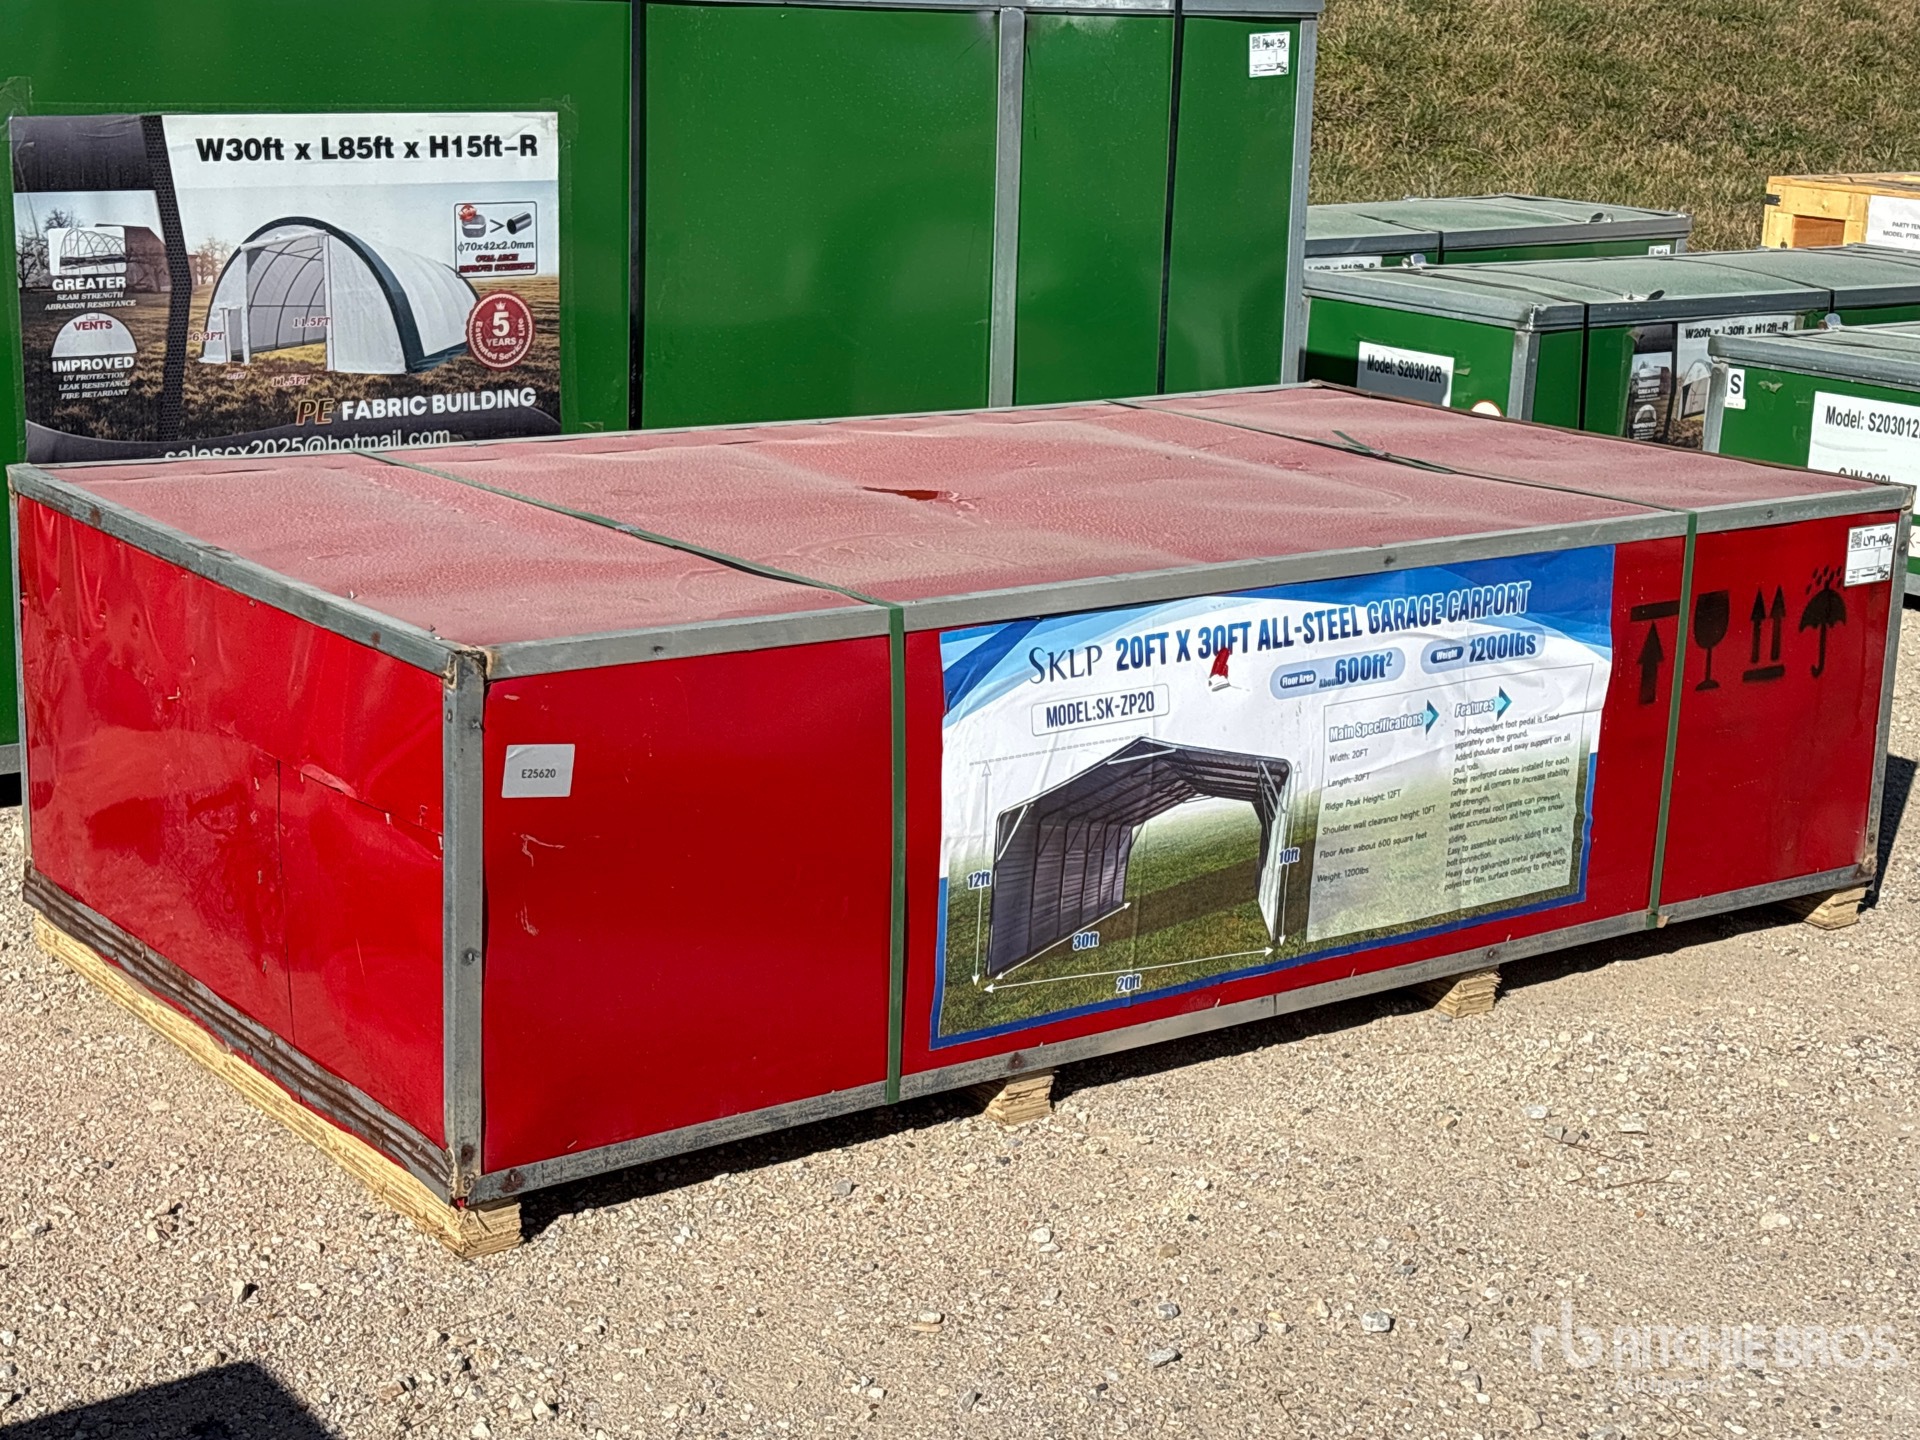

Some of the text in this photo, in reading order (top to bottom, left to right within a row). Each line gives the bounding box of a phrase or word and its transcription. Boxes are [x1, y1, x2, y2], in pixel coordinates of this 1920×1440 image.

[196, 134, 538, 162] W30ft x L85ft x H15ft-R
[1883, 230, 1904, 238] MODEL:
[52, 276, 126, 290] GREATER
[81, 291, 124, 300] STRENGTH
[44, 300, 136, 310] ABRASION RESISTANCE
[74, 320, 113, 330] VENTS
[292, 317, 330, 327] 11.5FT
[492, 312, 510, 336] 5
[1686, 326, 1711, 339] W20ft
[1755, 322, 1788, 334] H12ft-R
[192, 332, 224, 342] 6.3FT
[476, 321, 498, 360] Estimated
[498, 338, 524, 360] Service
[486, 338, 516, 346] YEARS
[52, 356, 134, 372] IMPROVED
[1366, 354, 1443, 384] Model: S203012R
[76, 372, 125, 381] PROTECTION
[82, 380, 130, 389] RESISTANCE
[1730, 374, 1742, 394] S
[82, 389, 129, 398] RETARDANT
[295, 387, 536, 426] PE FABRIC BUILDING
[1825, 405, 1920, 438] Model: S203012
[1028, 580, 1532, 684] SKLP 20FT X 30FT ALL-STEEL GARAGE CARPORT
[1436, 632, 1536, 662] Weight 1200lbs
[1282, 673, 1314, 686] Floor Area
[1046, 691, 1155, 728] MODEL:SK-ZP20
[1454, 700, 1495, 718] Features
[1329, 713, 1424, 742] Main Specifications
[1467, 724, 1503, 735] independent
[1519, 718, 1535, 728] pedal
[1454, 738, 1484, 750] separately
[1507, 730, 1528, 742] ground.
[1330, 748, 1368, 763] Width: 20FT
[1455, 751, 1472, 762] Added
[1474, 748, 1500, 757] shoulder
[1502, 745, 1512, 753] and
[1530, 738, 1552, 748] support
[522, 768, 556, 779] E25620
[1452, 776, 1467, 785] Steel
[1470, 770, 1497, 782] reinforced
[1498, 766, 1519, 776] cables
[1521, 762, 1544, 772] installed
[1556, 756, 1570, 765] each
[1454, 765, 1465, 776] pull
[1328, 772, 1370, 788] Length: 30FT
[1451, 789, 1468, 797] rafter
[1491, 778, 1511, 789] corners
[1522, 773, 1546, 783] increase
[1547, 769, 1570, 779] stability
[1324, 802, 1343, 811] Ridge
[1346, 800, 1360, 808] Peak
[1387, 788, 1401, 799] 12FT
[1449, 810, 1471, 820] Vertical
[1473, 806, 1491, 815] metal
[1506, 800, 1522, 810] panels
[1537, 793, 1560, 802] prevent
[1450, 796, 1490, 808] and strength.
[1322, 824, 1351, 836] Shoulder
[1354, 820, 1366, 829] wall
[1368, 816, 1398, 827] clearance
[1422, 805, 1436, 815] 10FT
[1449, 822, 1465, 832] water
[1466, 815, 1507, 828] accumulation
[1509, 812, 1518, 820] and
[1520, 809, 1532, 817] help
[1548, 803, 1564, 811] snow
[1338, 847, 1356, 856] Area:
[1358, 843, 1376, 852] about
[1378, 838, 1391, 848] 600
[1393, 834, 1413, 844] square
[1416, 831, 1427, 839] feet
[1448, 848, 1460, 856] Easy
[1470, 838, 1497, 850] assemble
[1551, 824, 1562, 833] and
[1449, 834, 1467, 844] sliding.
[1279, 849, 1300, 865] 10ft
[1445, 847, 1566, 878] Heavy duty galvanized metal grating with
[1446, 852, 1492, 867] bolt connection.
[968, 870, 991, 888] 12ft
[1317, 867, 1369, 883] Weight: 1200lbs
[1444, 878, 1471, 892] polyester
[1488, 871, 1508, 880] surface
[1510, 866, 1532, 876] coating
[1541, 859, 1566, 869] enhance
[1072, 932, 1100, 951] 30ft
[1116, 974, 1142, 994] 20ft
